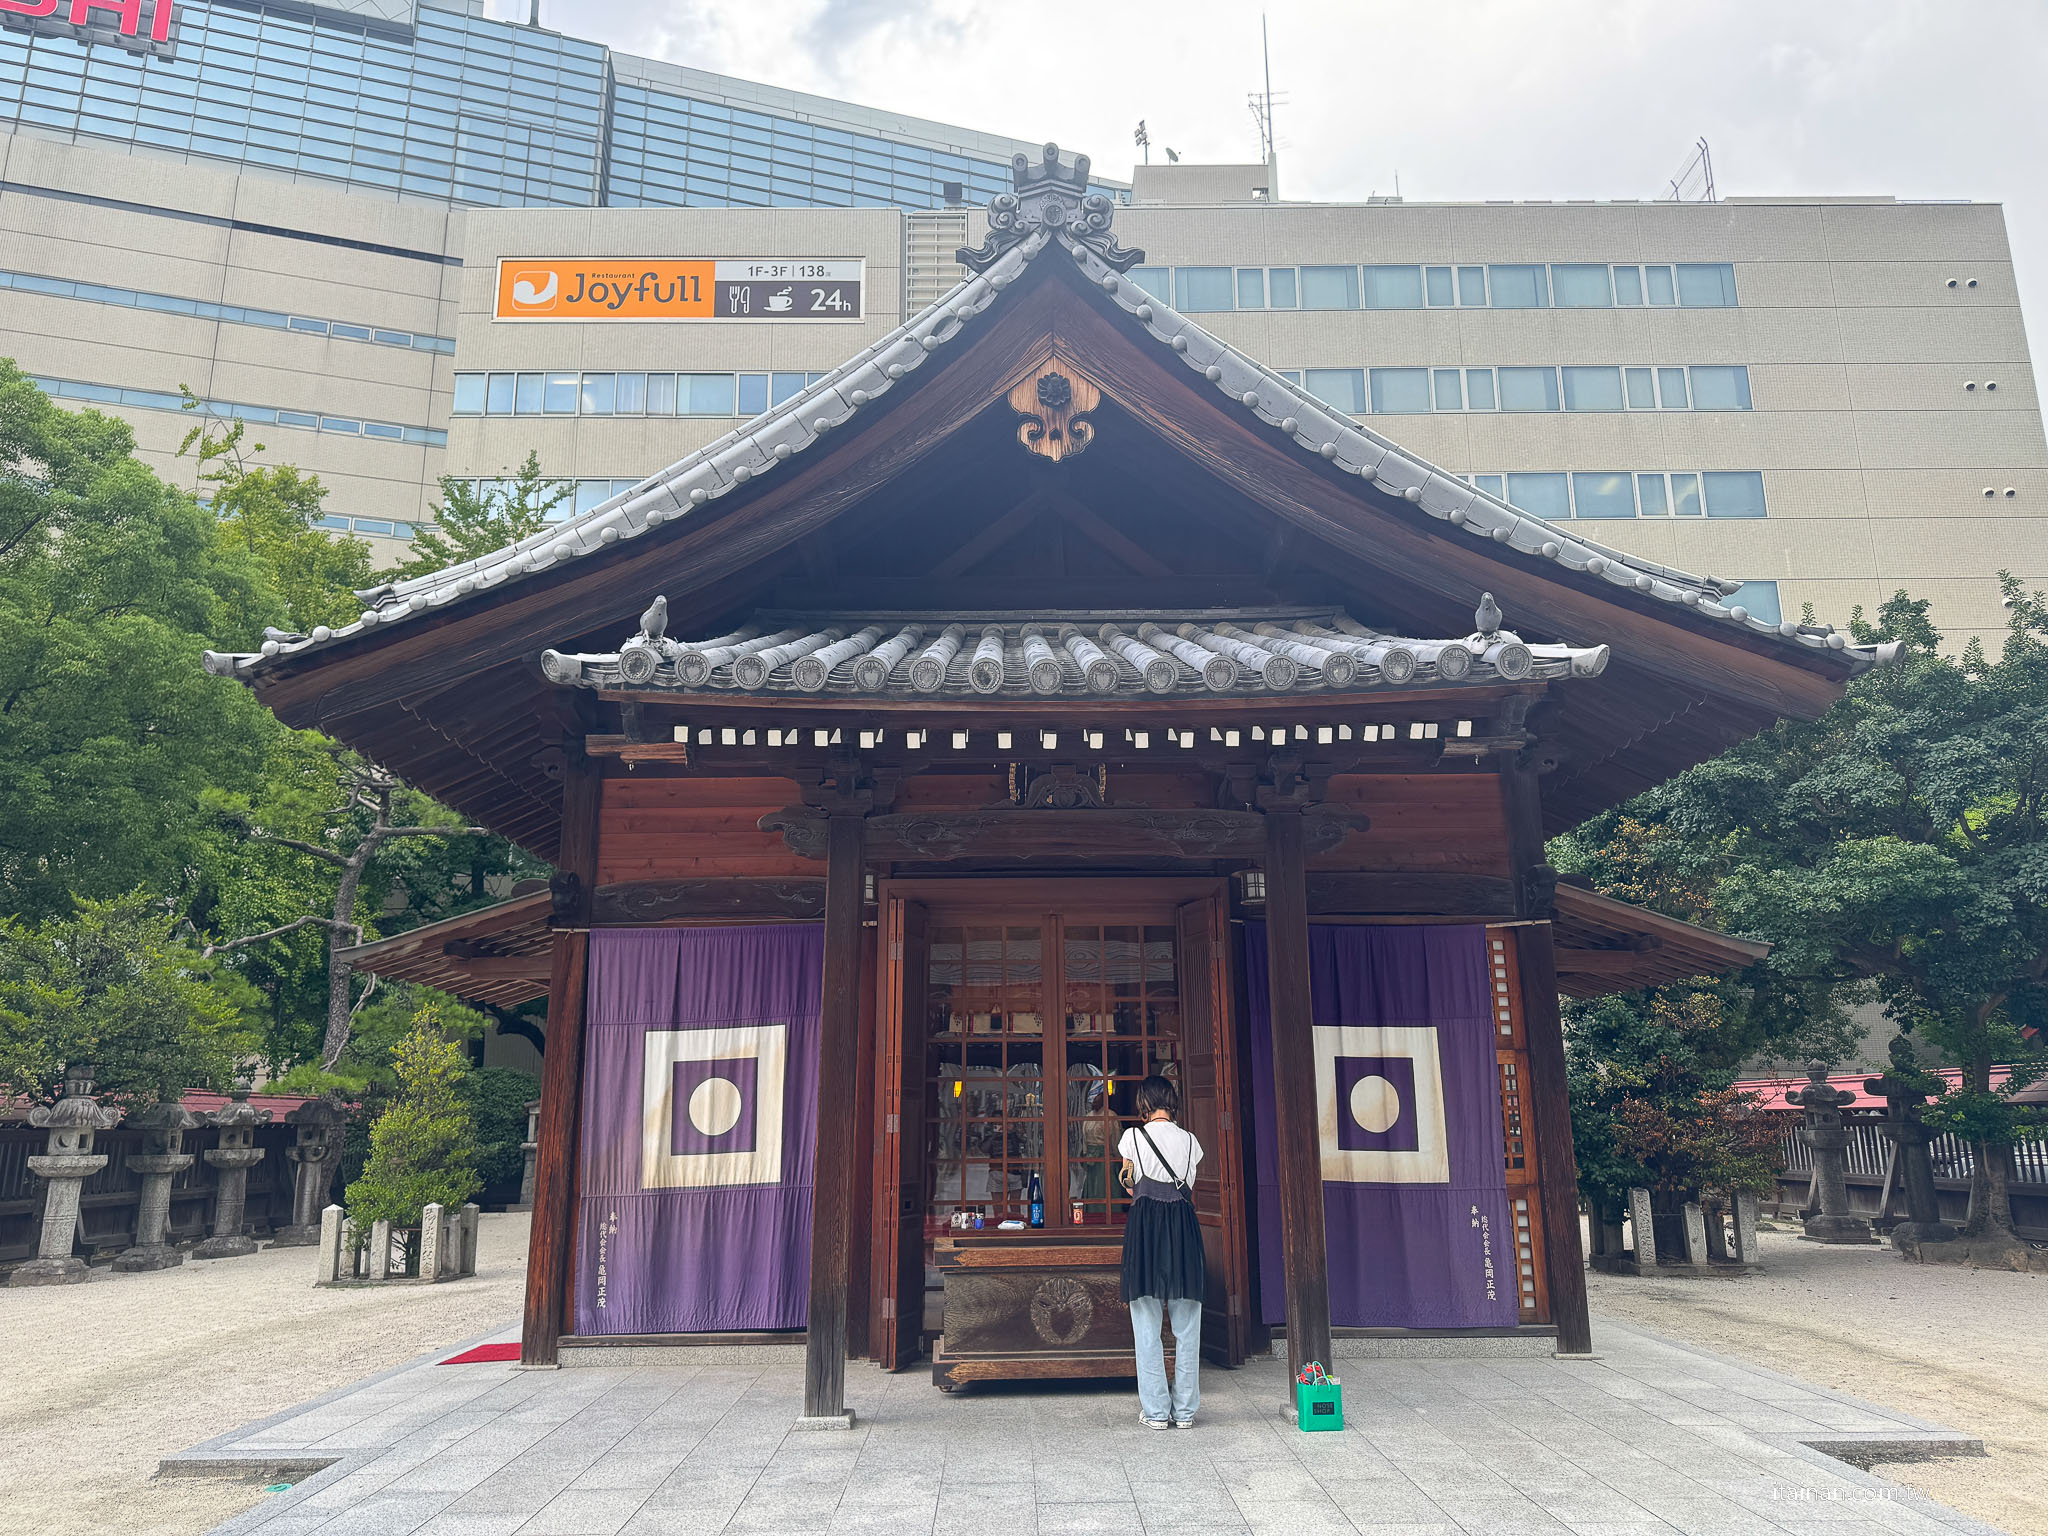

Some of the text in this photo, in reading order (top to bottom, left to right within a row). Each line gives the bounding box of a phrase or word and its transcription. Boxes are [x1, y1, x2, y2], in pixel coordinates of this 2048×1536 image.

[747, 265, 788, 277] 1F-3F
[565, 271, 702, 310] Joyfull
[810, 288, 852, 311] 24h
